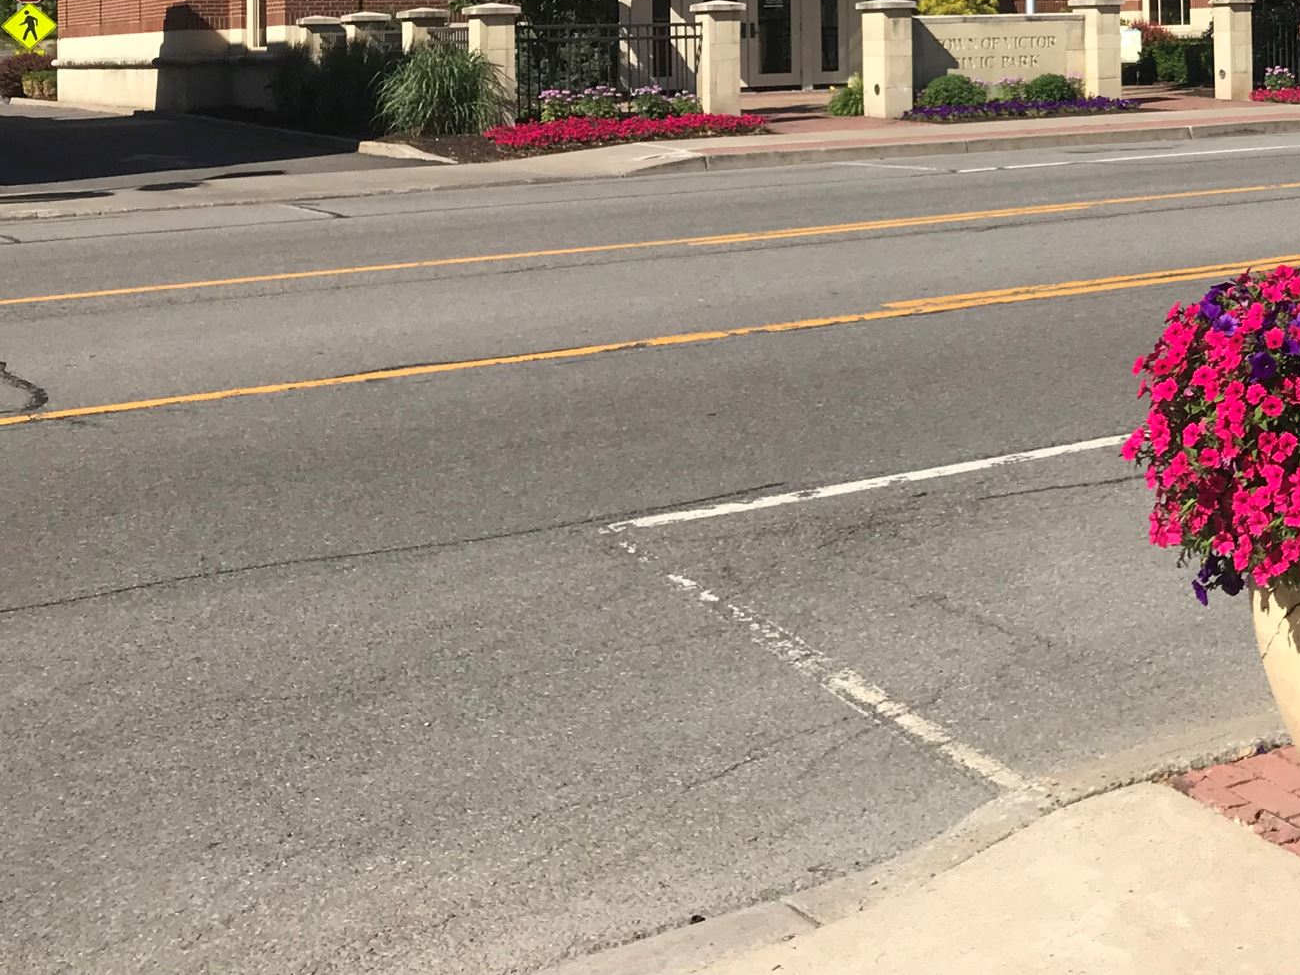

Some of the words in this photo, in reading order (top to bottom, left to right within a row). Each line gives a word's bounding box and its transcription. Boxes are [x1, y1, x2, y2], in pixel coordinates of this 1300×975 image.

[980, 37, 1001, 50] OF
[1003, 35, 1057, 50] VICTOR
[956, 56, 995, 69] IVIC
[1001, 54, 1041, 69] PARK
